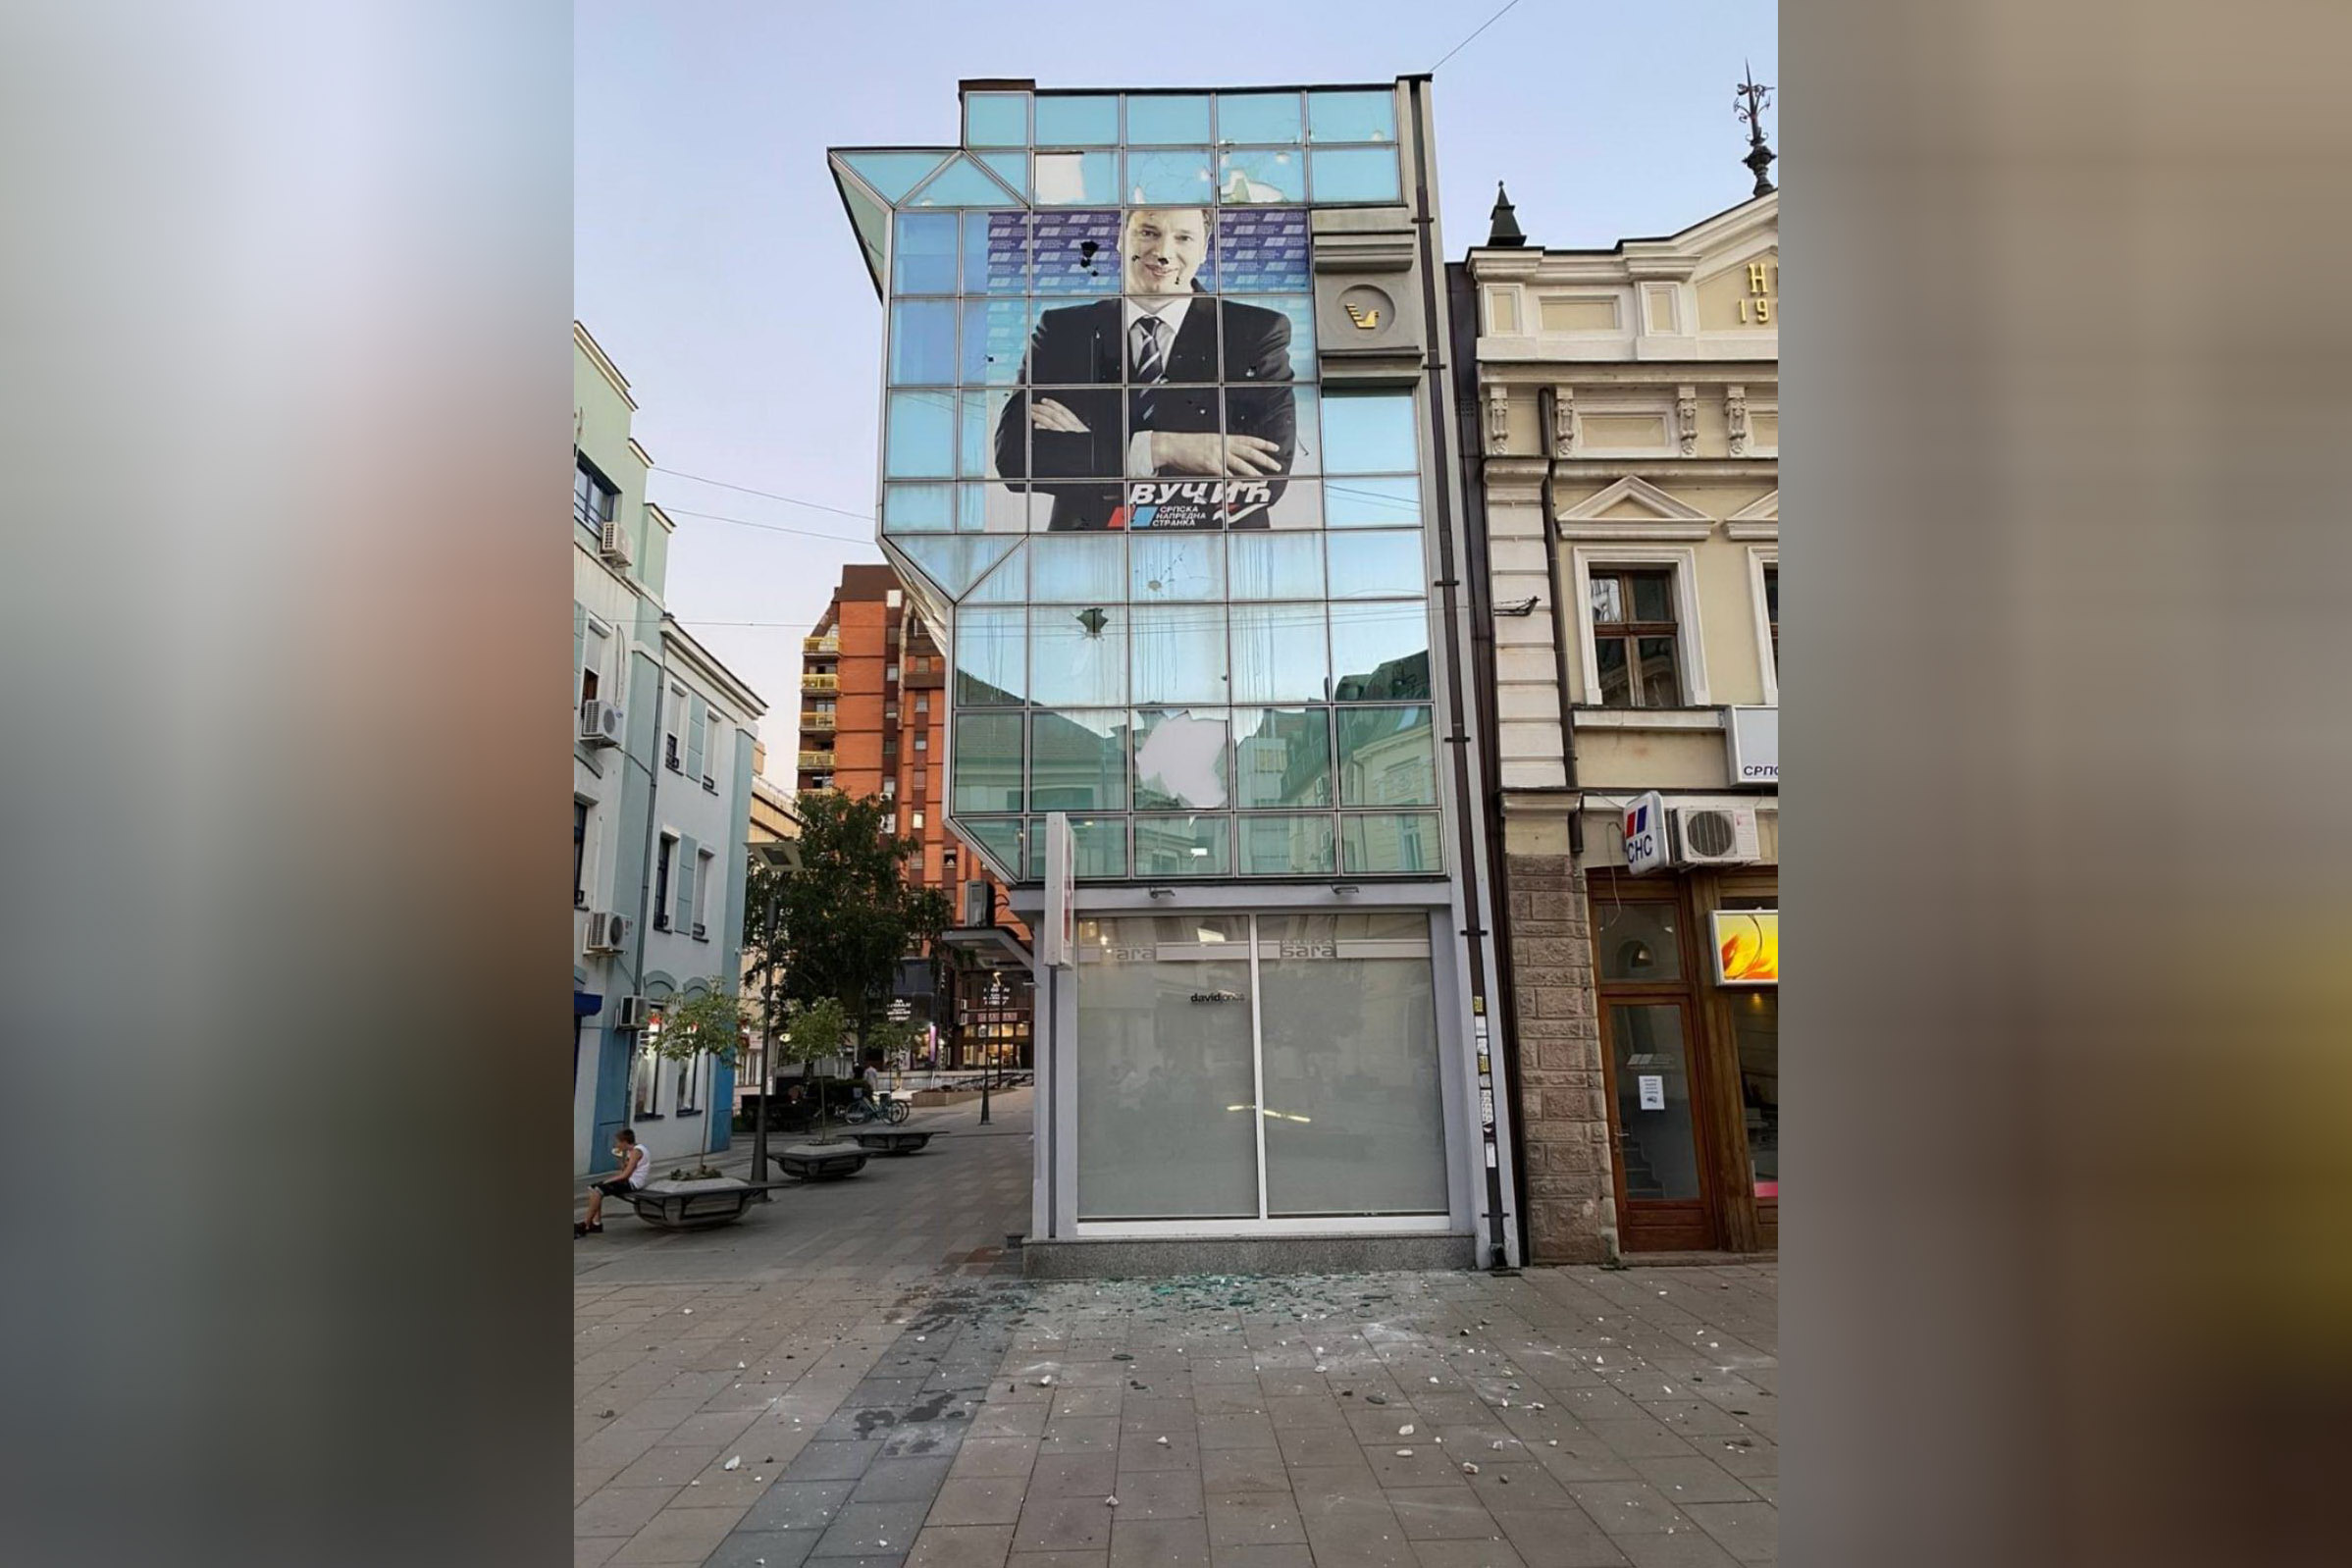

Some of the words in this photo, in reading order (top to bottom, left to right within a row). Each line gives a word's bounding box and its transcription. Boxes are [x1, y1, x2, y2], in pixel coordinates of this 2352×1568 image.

[1129, 482, 1272, 504] ВУЧИЋ
[1627, 834, 1653, 863] СНС
[1281, 945, 1335, 959] sara
